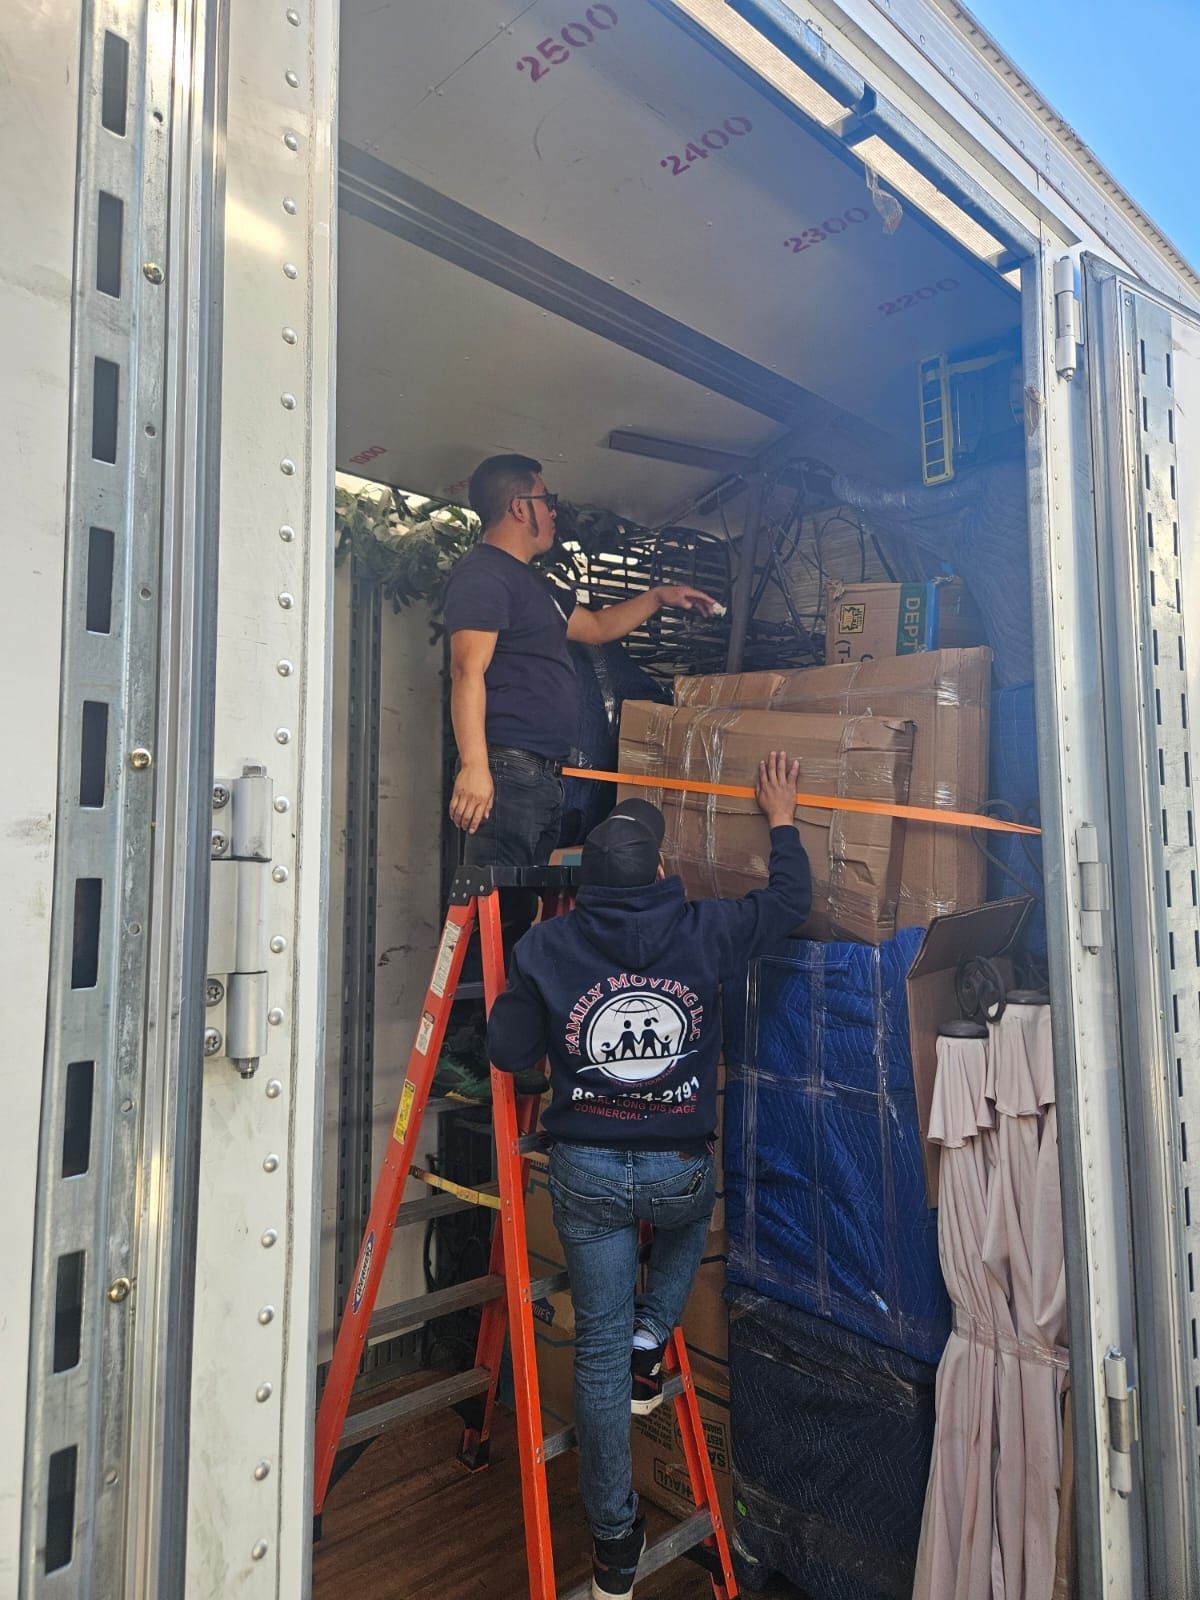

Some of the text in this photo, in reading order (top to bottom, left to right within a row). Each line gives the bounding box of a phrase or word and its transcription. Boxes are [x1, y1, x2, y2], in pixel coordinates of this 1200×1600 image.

[516, 3, 618, 82] 2500
[660, 116, 753, 176] 2400
[783, 207, 870, 254] 2300
[877, 278, 960, 316] 2200
[565, 982, 604, 1055] FAMILY
[607, 973, 698, 1007] MOVING
[574, 1102, 643, 1120] COMMERCIAL
[616, 1098, 646, 1110] LONG
